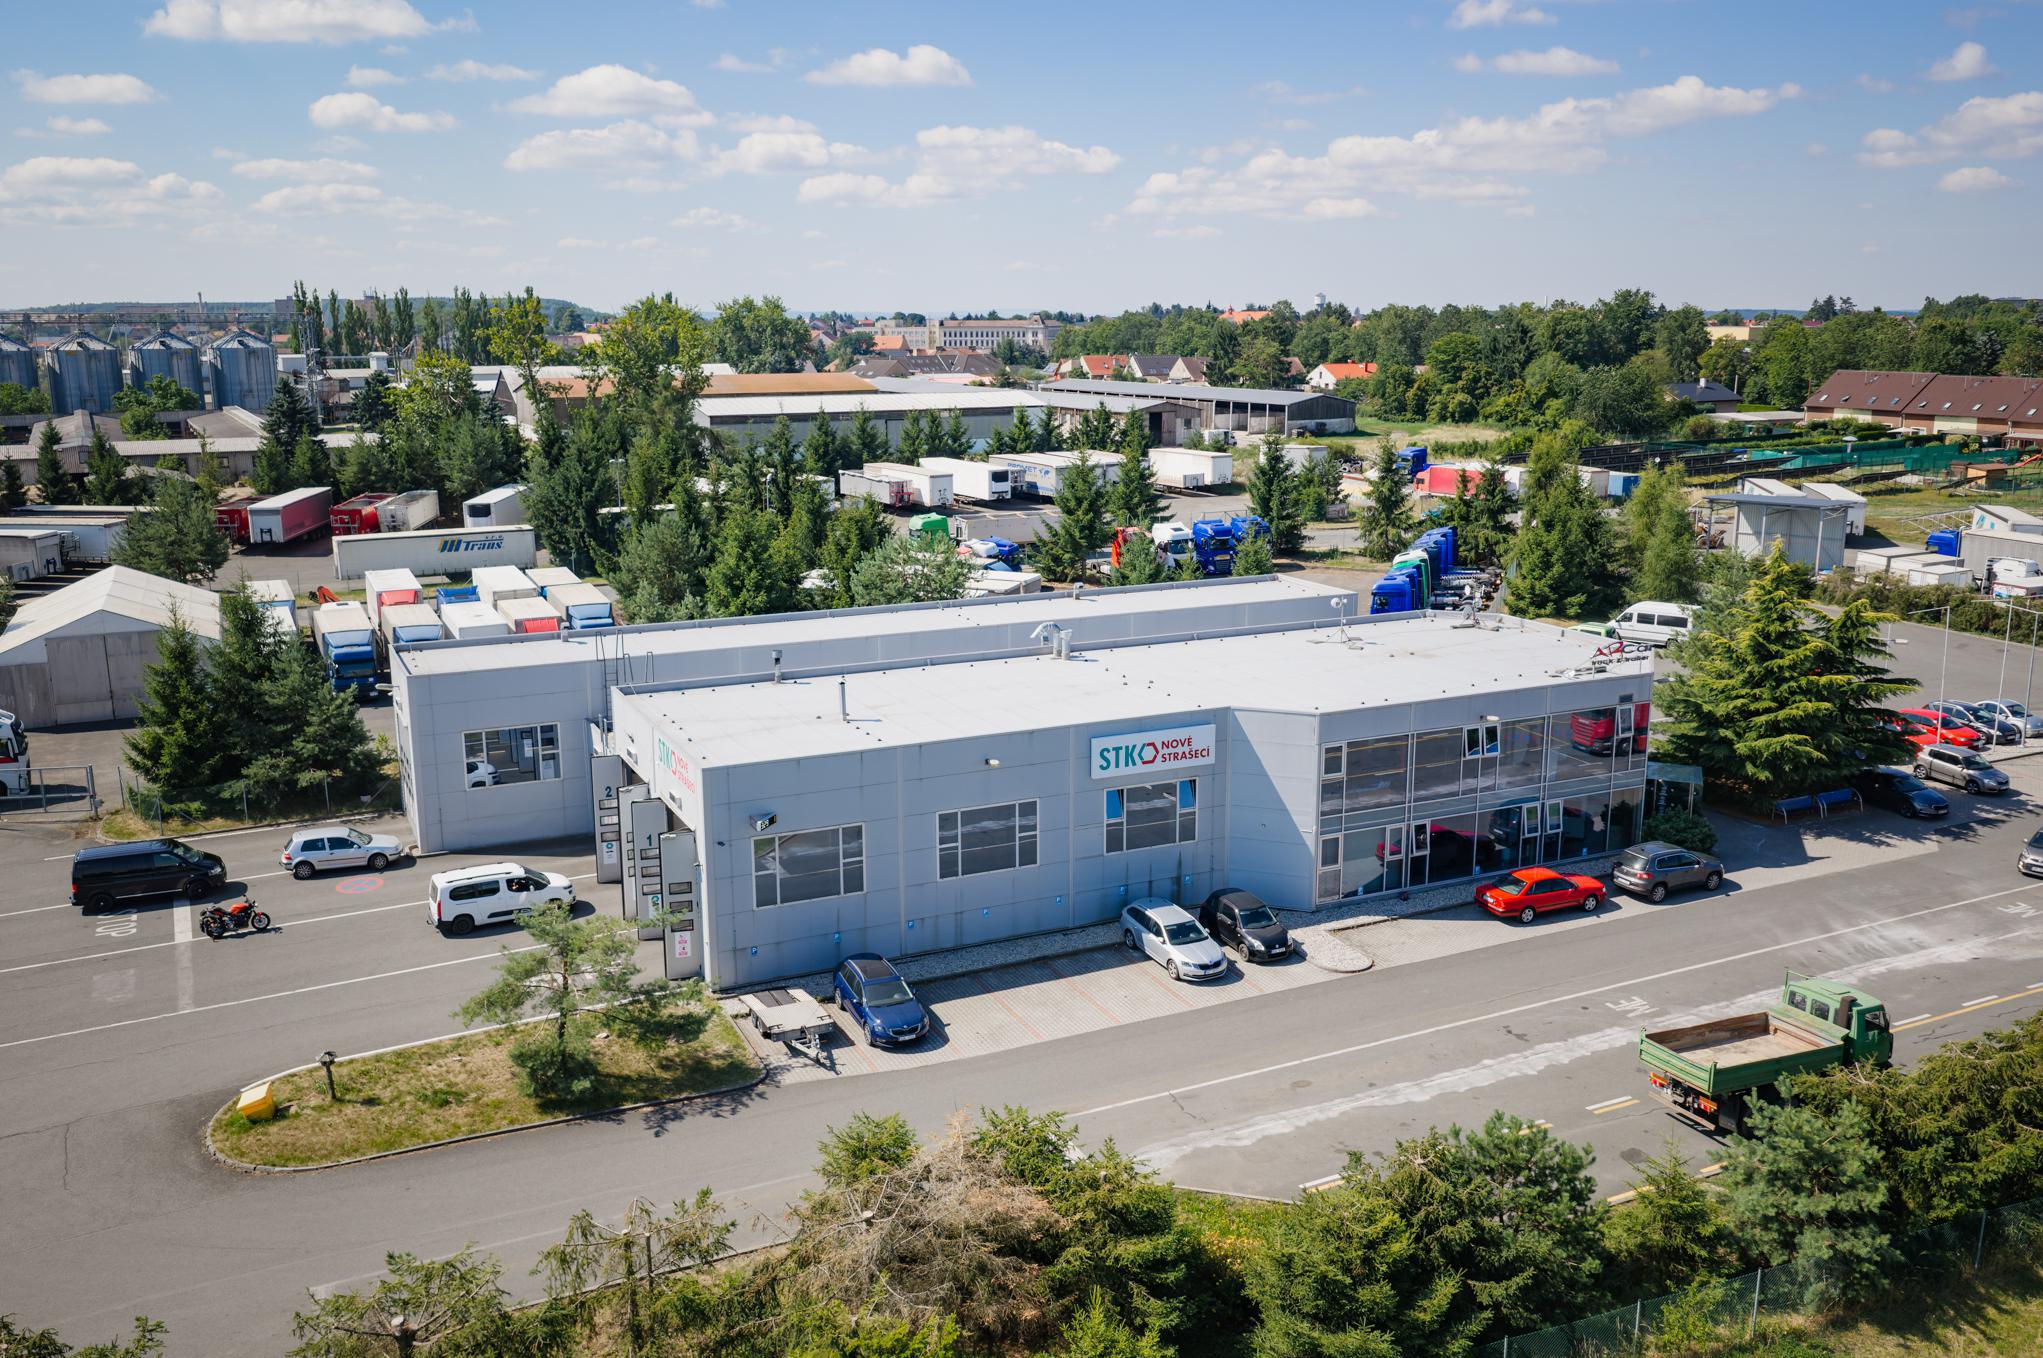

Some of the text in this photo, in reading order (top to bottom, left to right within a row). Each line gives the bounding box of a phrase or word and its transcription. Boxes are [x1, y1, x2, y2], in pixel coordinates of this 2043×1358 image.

[463, 539, 503, 551] Trans
[1161, 735, 1193, 750] NOVÉ
[1161, 745, 1210, 763] STRAŠECÍ
[605, 786, 612, 798] 2
[647, 834, 652, 847] 1
